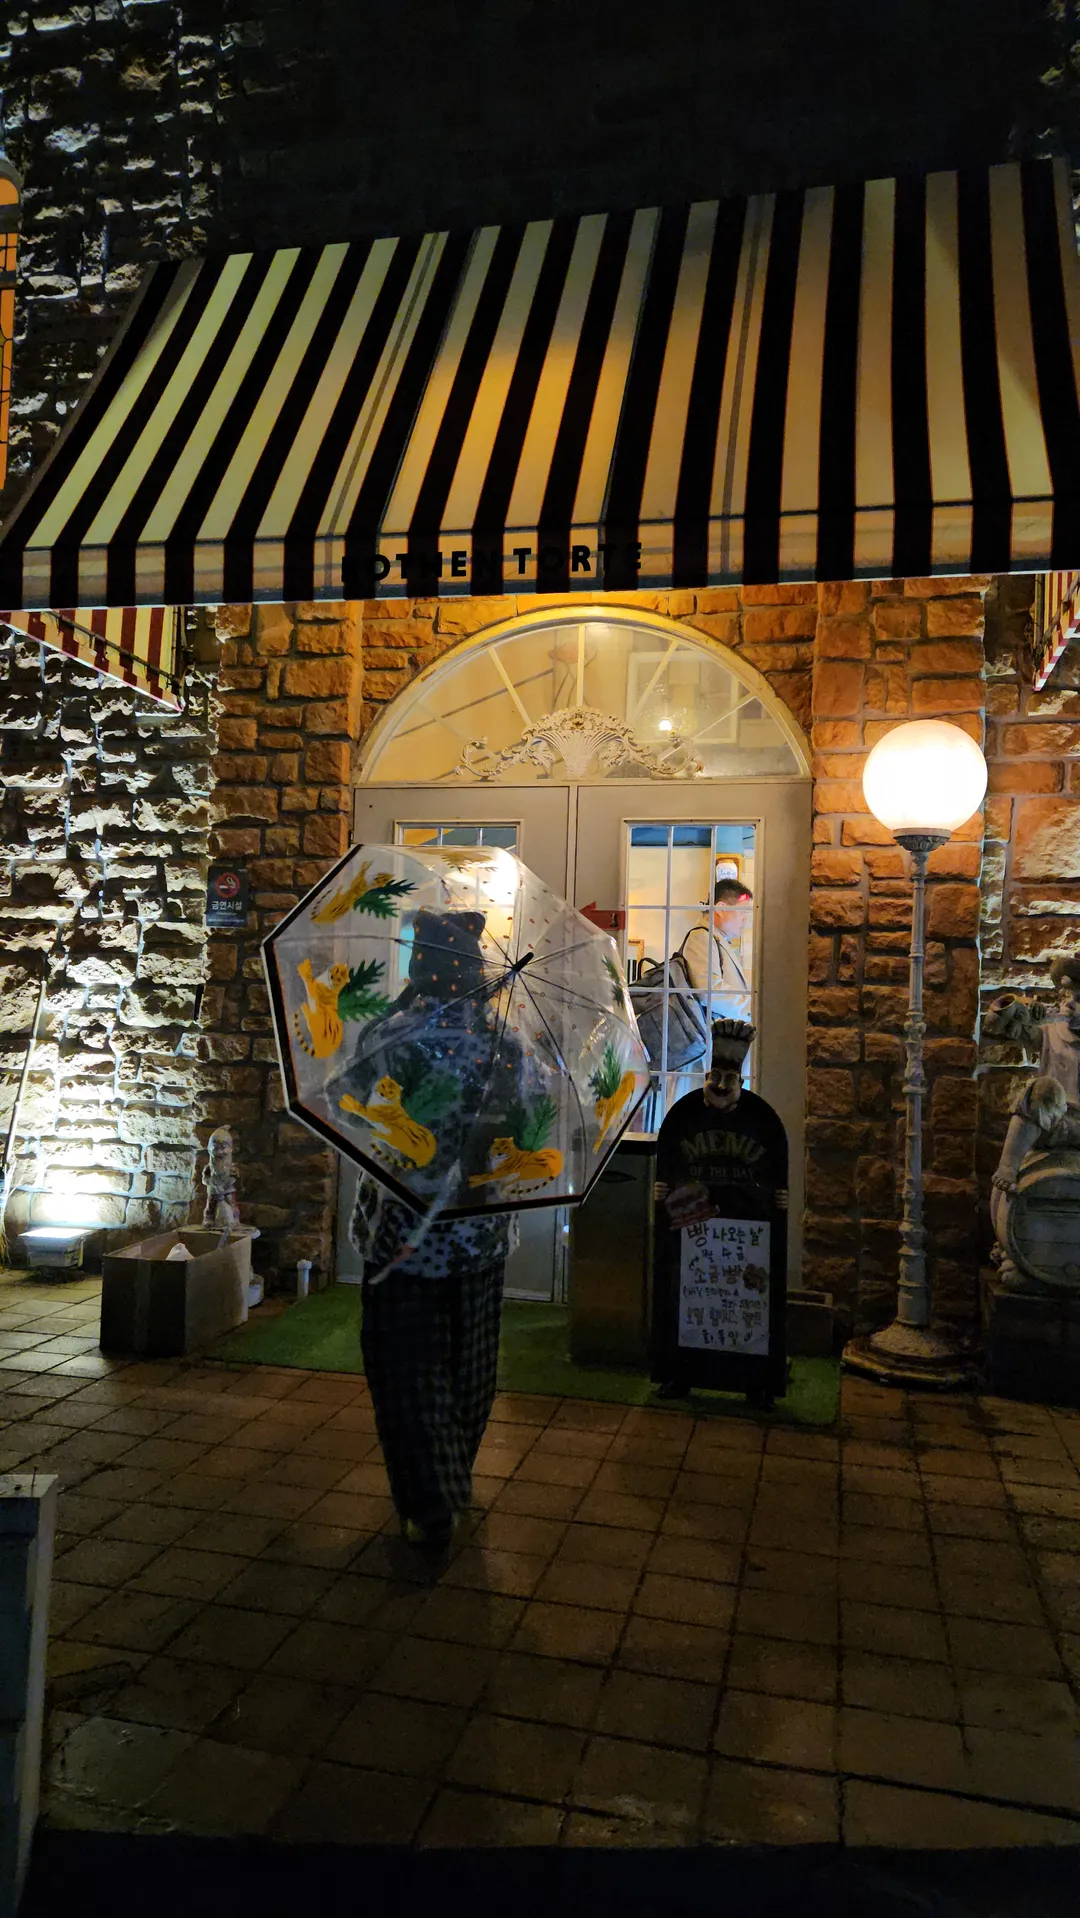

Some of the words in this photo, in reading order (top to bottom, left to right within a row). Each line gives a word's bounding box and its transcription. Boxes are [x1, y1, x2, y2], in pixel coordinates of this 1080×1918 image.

[514, 543, 641, 574] TORTE
[211, 900, 243, 911] 금연시설
[678, 1129, 768, 1164] MENU
[690, 1165, 704, 1177] OF
[708, 1165, 728, 1178] THE
[732, 1166, 755, 1179] DAY
[687, 1222, 709, 1247] 빵
[713, 1226, 746, 1244] 나오는
[750, 1226, 764, 1247] 날
[694, 1264, 742, 1284] 소금빵
